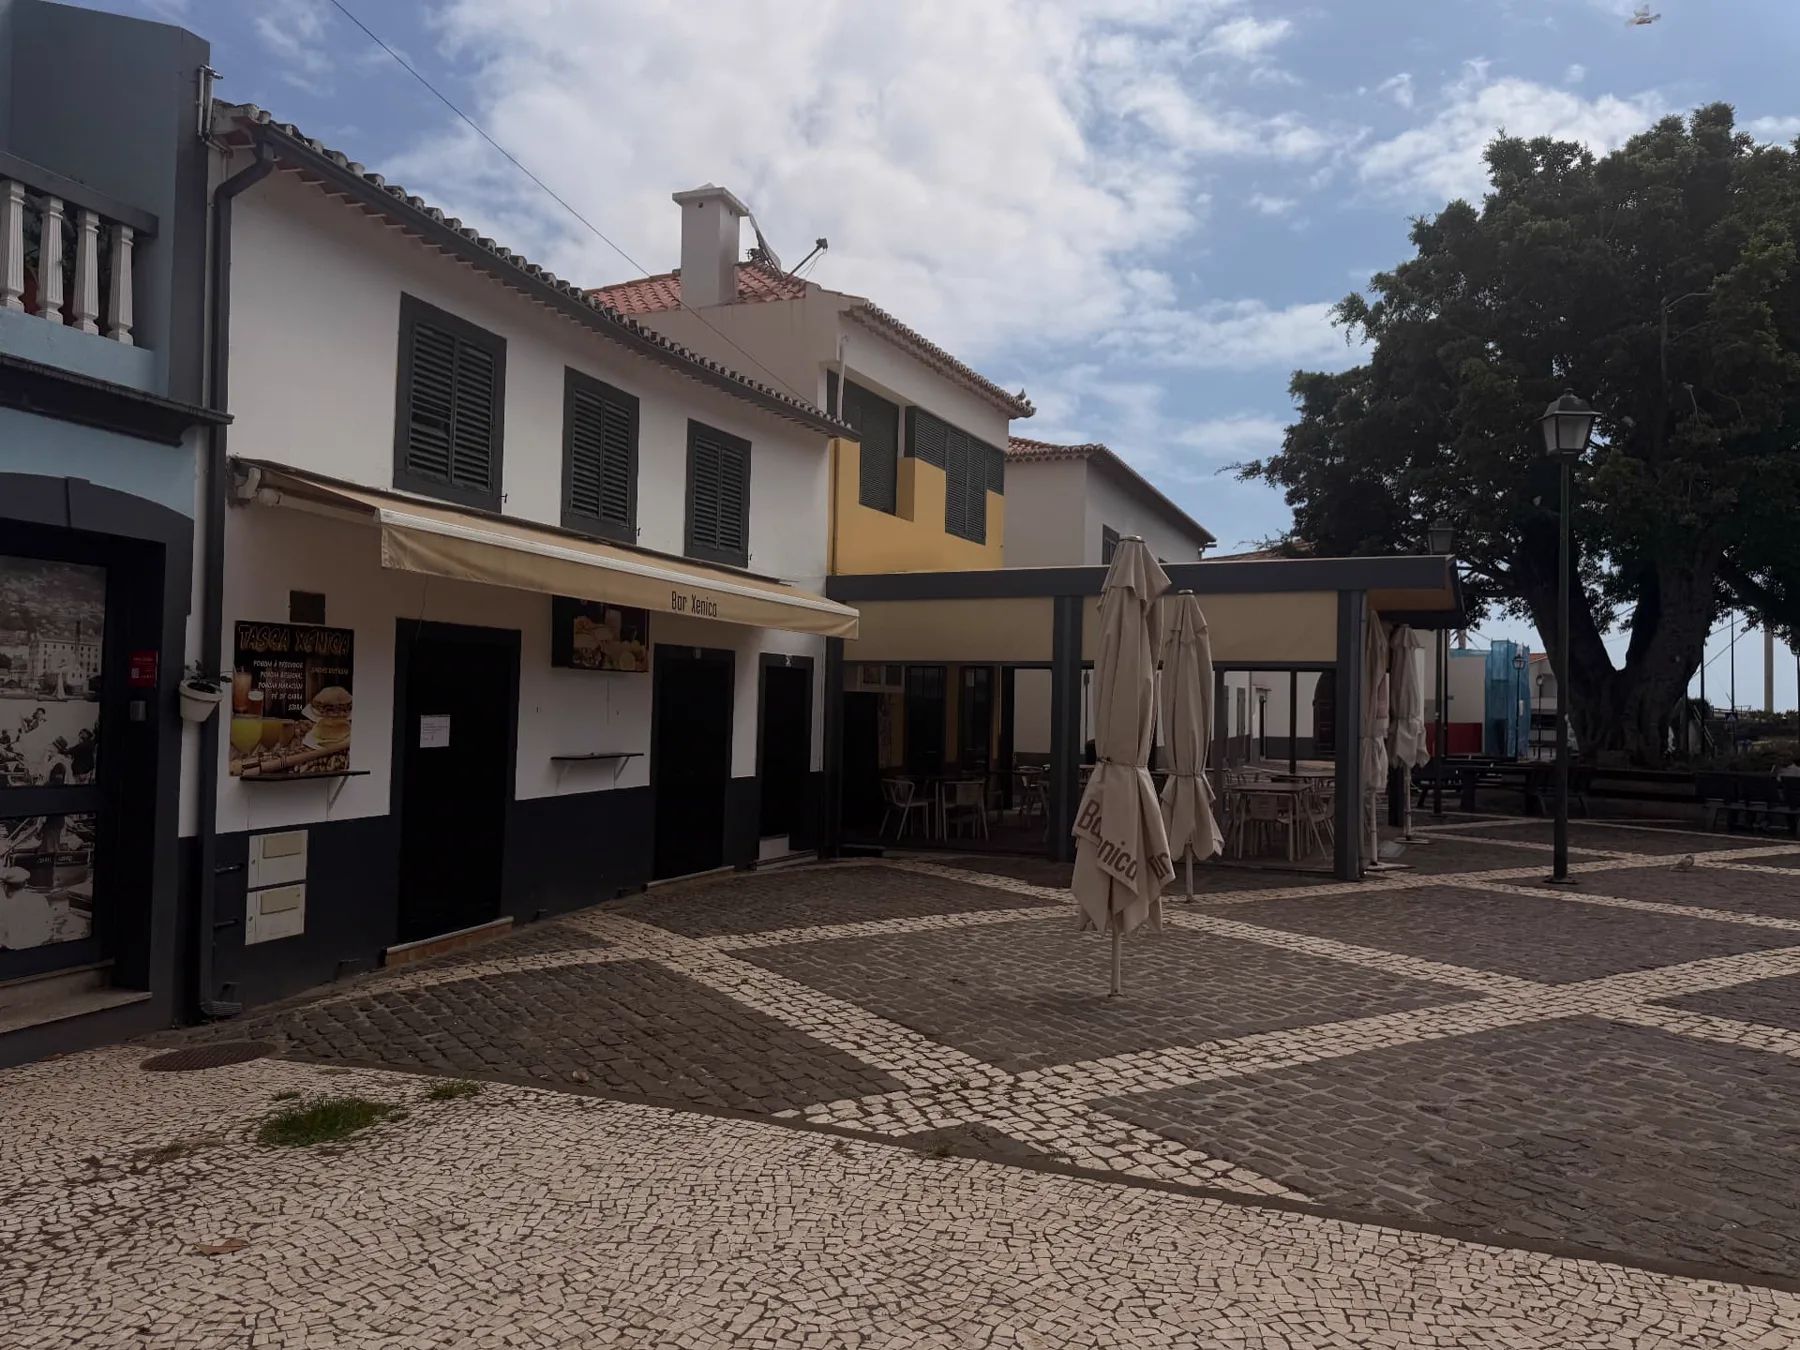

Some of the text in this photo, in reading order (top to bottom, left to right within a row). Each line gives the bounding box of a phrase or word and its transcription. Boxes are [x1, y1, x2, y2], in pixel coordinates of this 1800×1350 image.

[671, 591, 717, 617] Bar Xenica
[239, 624, 291, 653] TASCA
